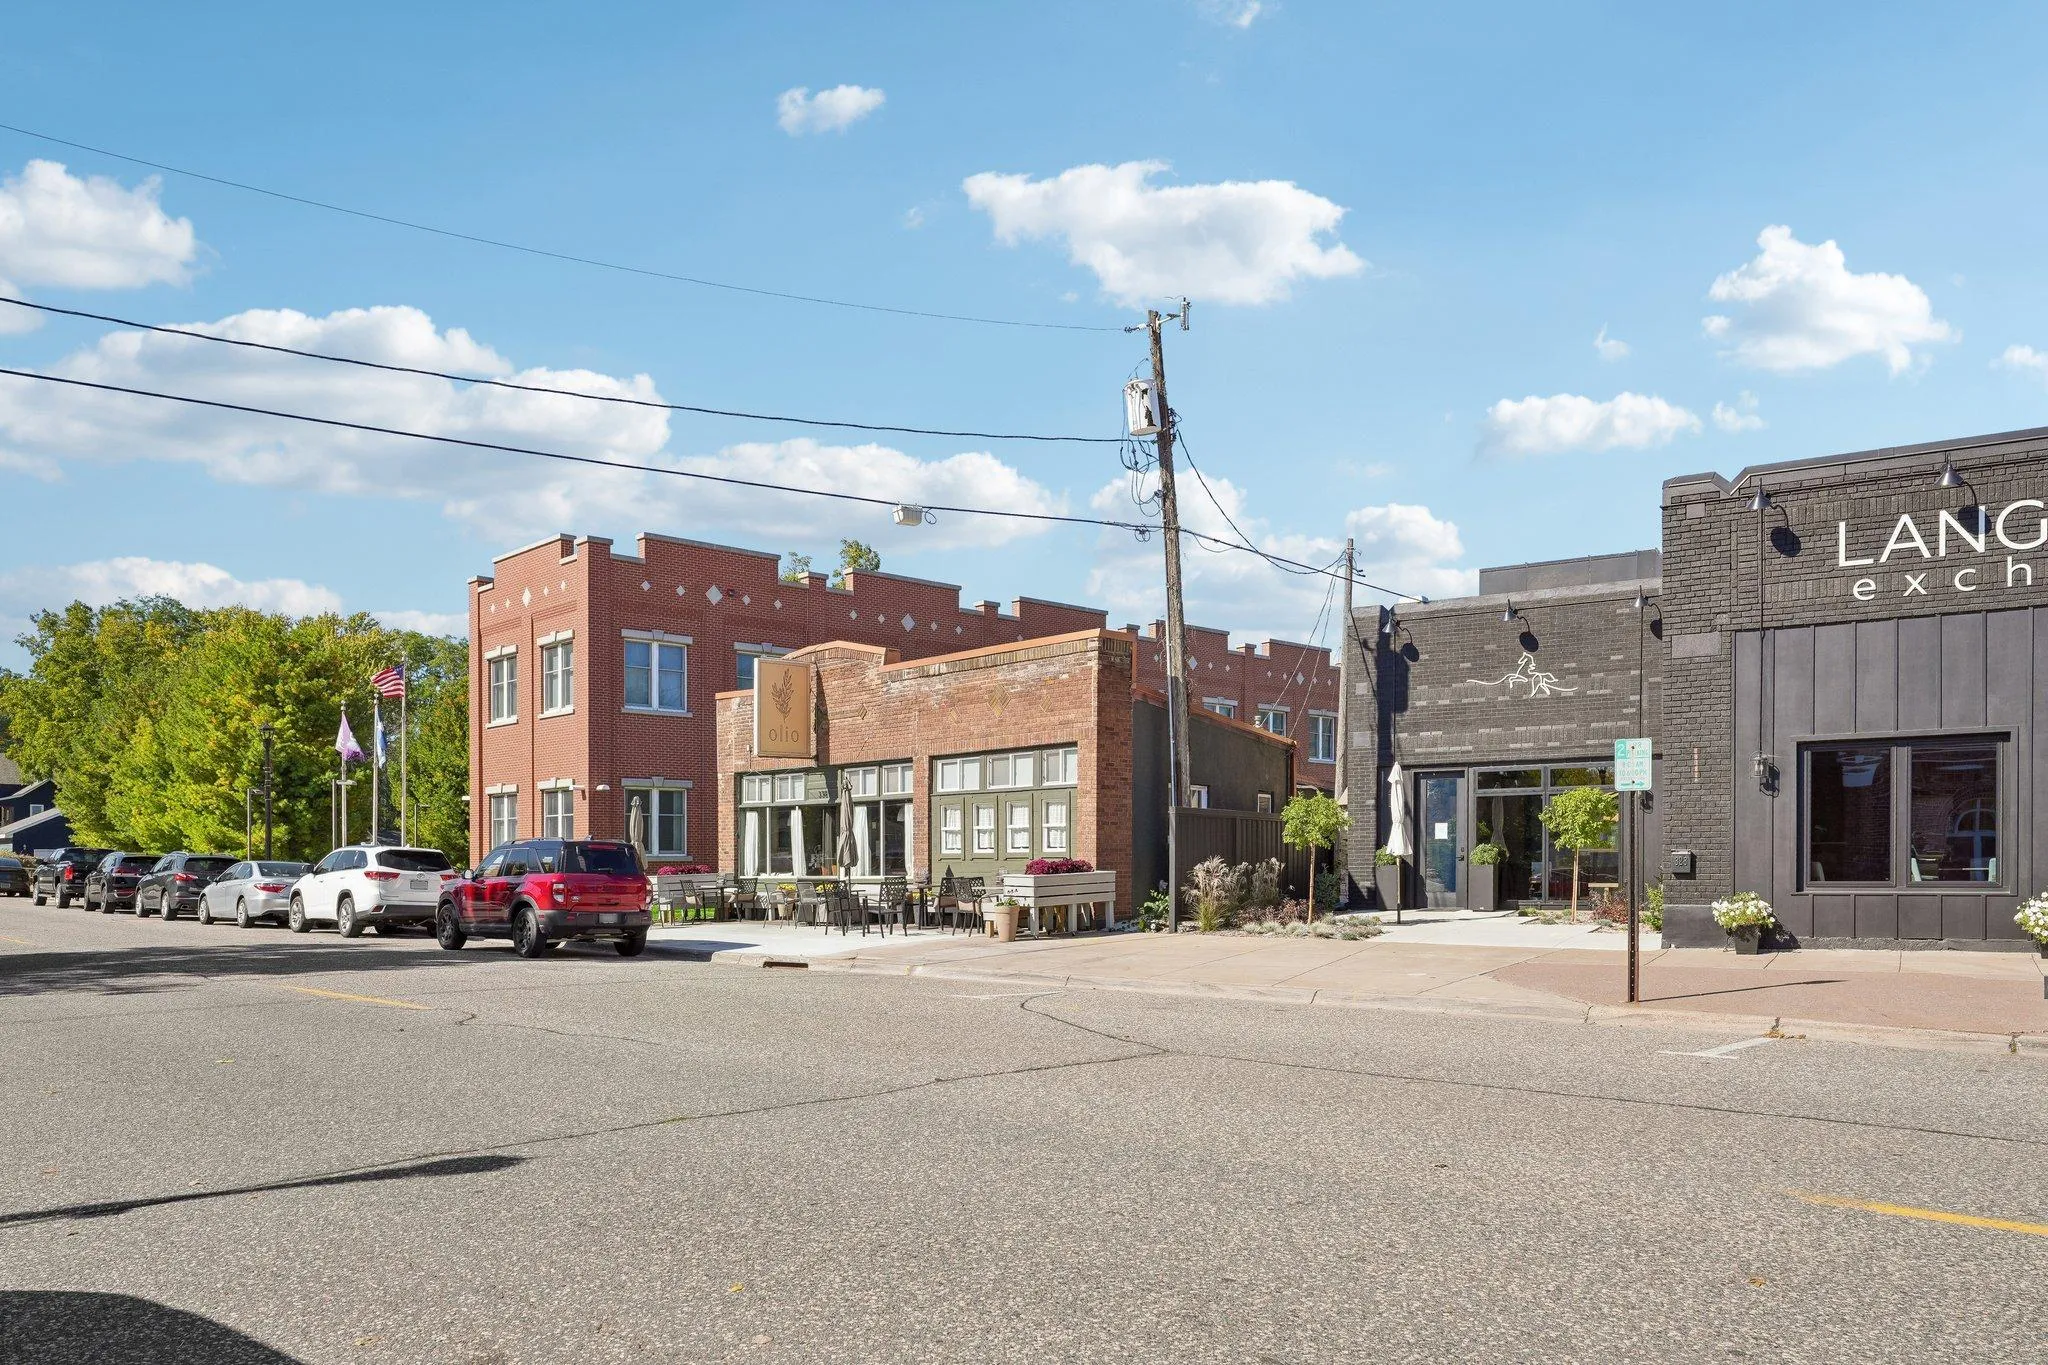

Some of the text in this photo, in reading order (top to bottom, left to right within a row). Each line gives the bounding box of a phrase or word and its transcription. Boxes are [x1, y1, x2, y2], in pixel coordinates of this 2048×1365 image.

[1838, 499, 2048, 567] LANG
[1852, 556, 2032, 601] exch
[769, 725, 799, 743] olio
[1617, 743, 1625, 757] 2
